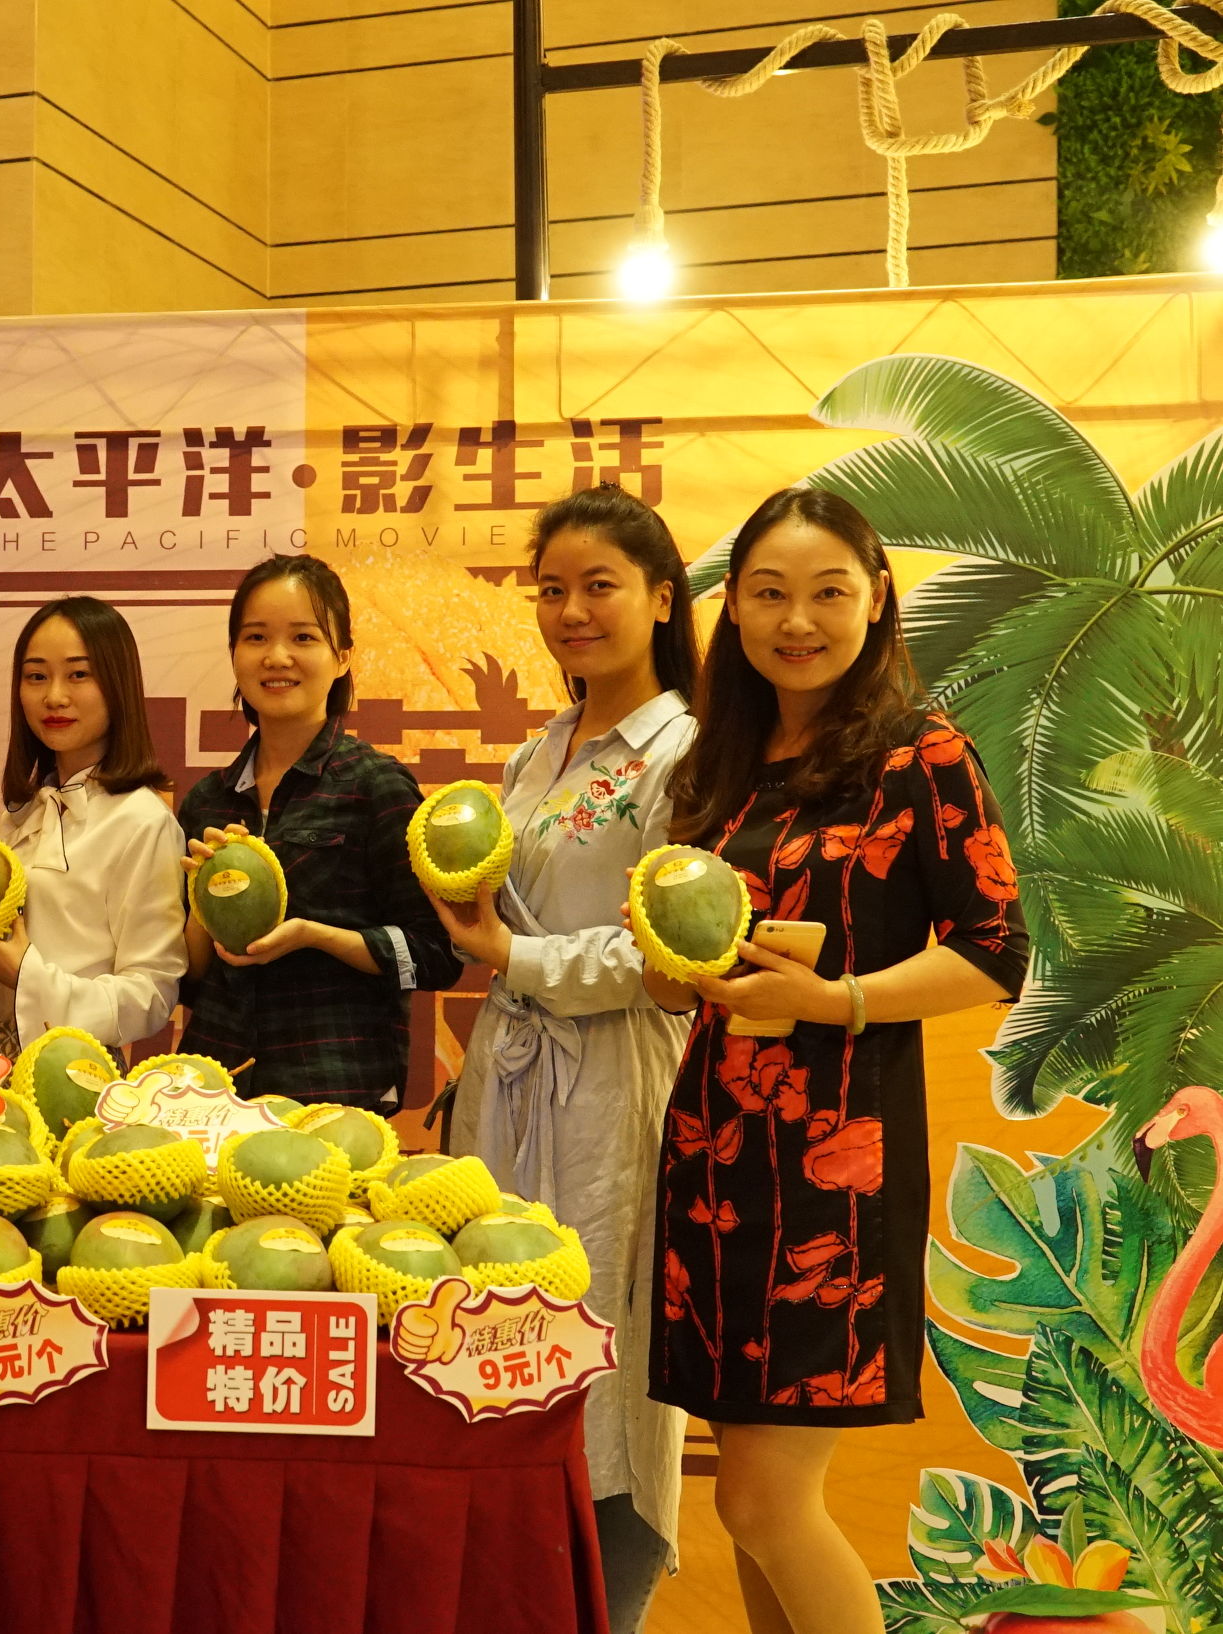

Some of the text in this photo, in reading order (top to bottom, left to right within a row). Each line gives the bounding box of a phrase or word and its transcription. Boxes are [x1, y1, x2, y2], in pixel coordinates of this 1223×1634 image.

[83, 528, 308, 551] PACIFIC
[335, 525, 507, 549] MOVIE
[207, 1308, 307, 1359] 精品
[466, 1306, 557, 1359] 特惠价
[327, 1315, 358, 1414] SALE
[478, 1343, 574, 1391] 9元/个
[206, 1365, 307, 1415] 特价
